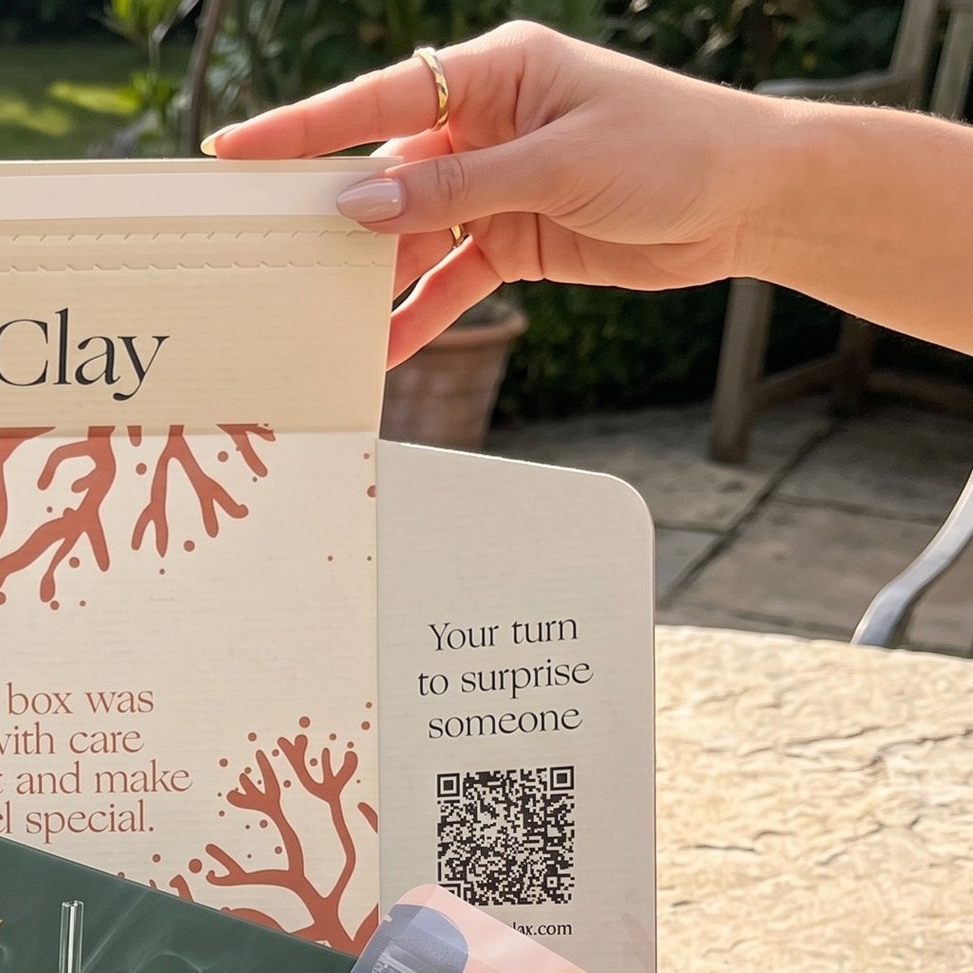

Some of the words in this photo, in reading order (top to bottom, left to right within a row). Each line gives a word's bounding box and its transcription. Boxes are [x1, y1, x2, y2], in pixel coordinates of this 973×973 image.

[428, 622, 499, 651] Your
[511, 618, 578, 645] turn
[418, 672, 449, 696] to
[461, 659, 594, 699] surprise
[6, 682, 74, 716] box
[85, 690, 154, 713] was
[428, 707, 584, 739] someone
[69, 729, 145, 753] care
[16, 760, 82, 795] and
[94, 759, 193, 793] make
[26, 799, 154, 844] special.
